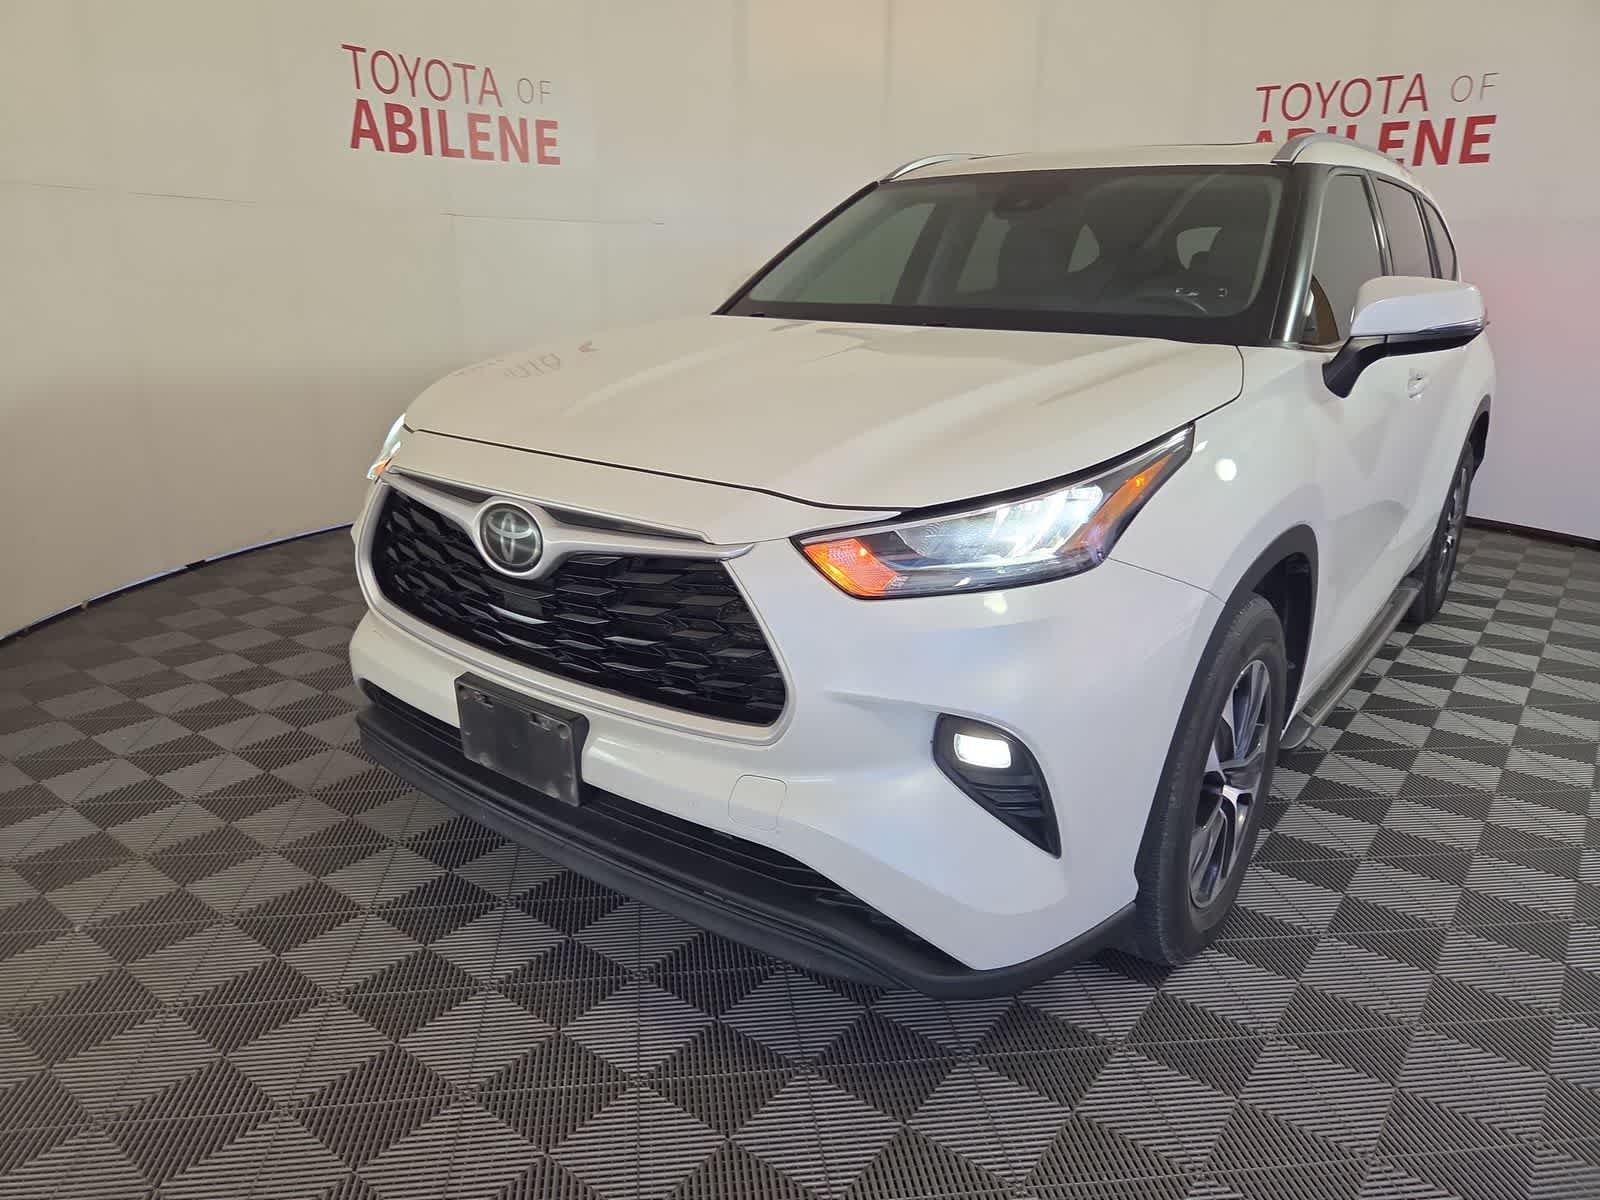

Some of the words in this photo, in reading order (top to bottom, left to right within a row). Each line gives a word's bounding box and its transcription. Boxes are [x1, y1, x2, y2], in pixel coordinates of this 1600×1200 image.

[341, 44, 503, 108] TOYOTA
[516, 77, 552, 104] OF
[1256, 73, 1429, 122] TOYOTA
[1451, 72, 1500, 102] OF
[350, 98, 561, 165] ABILENE
